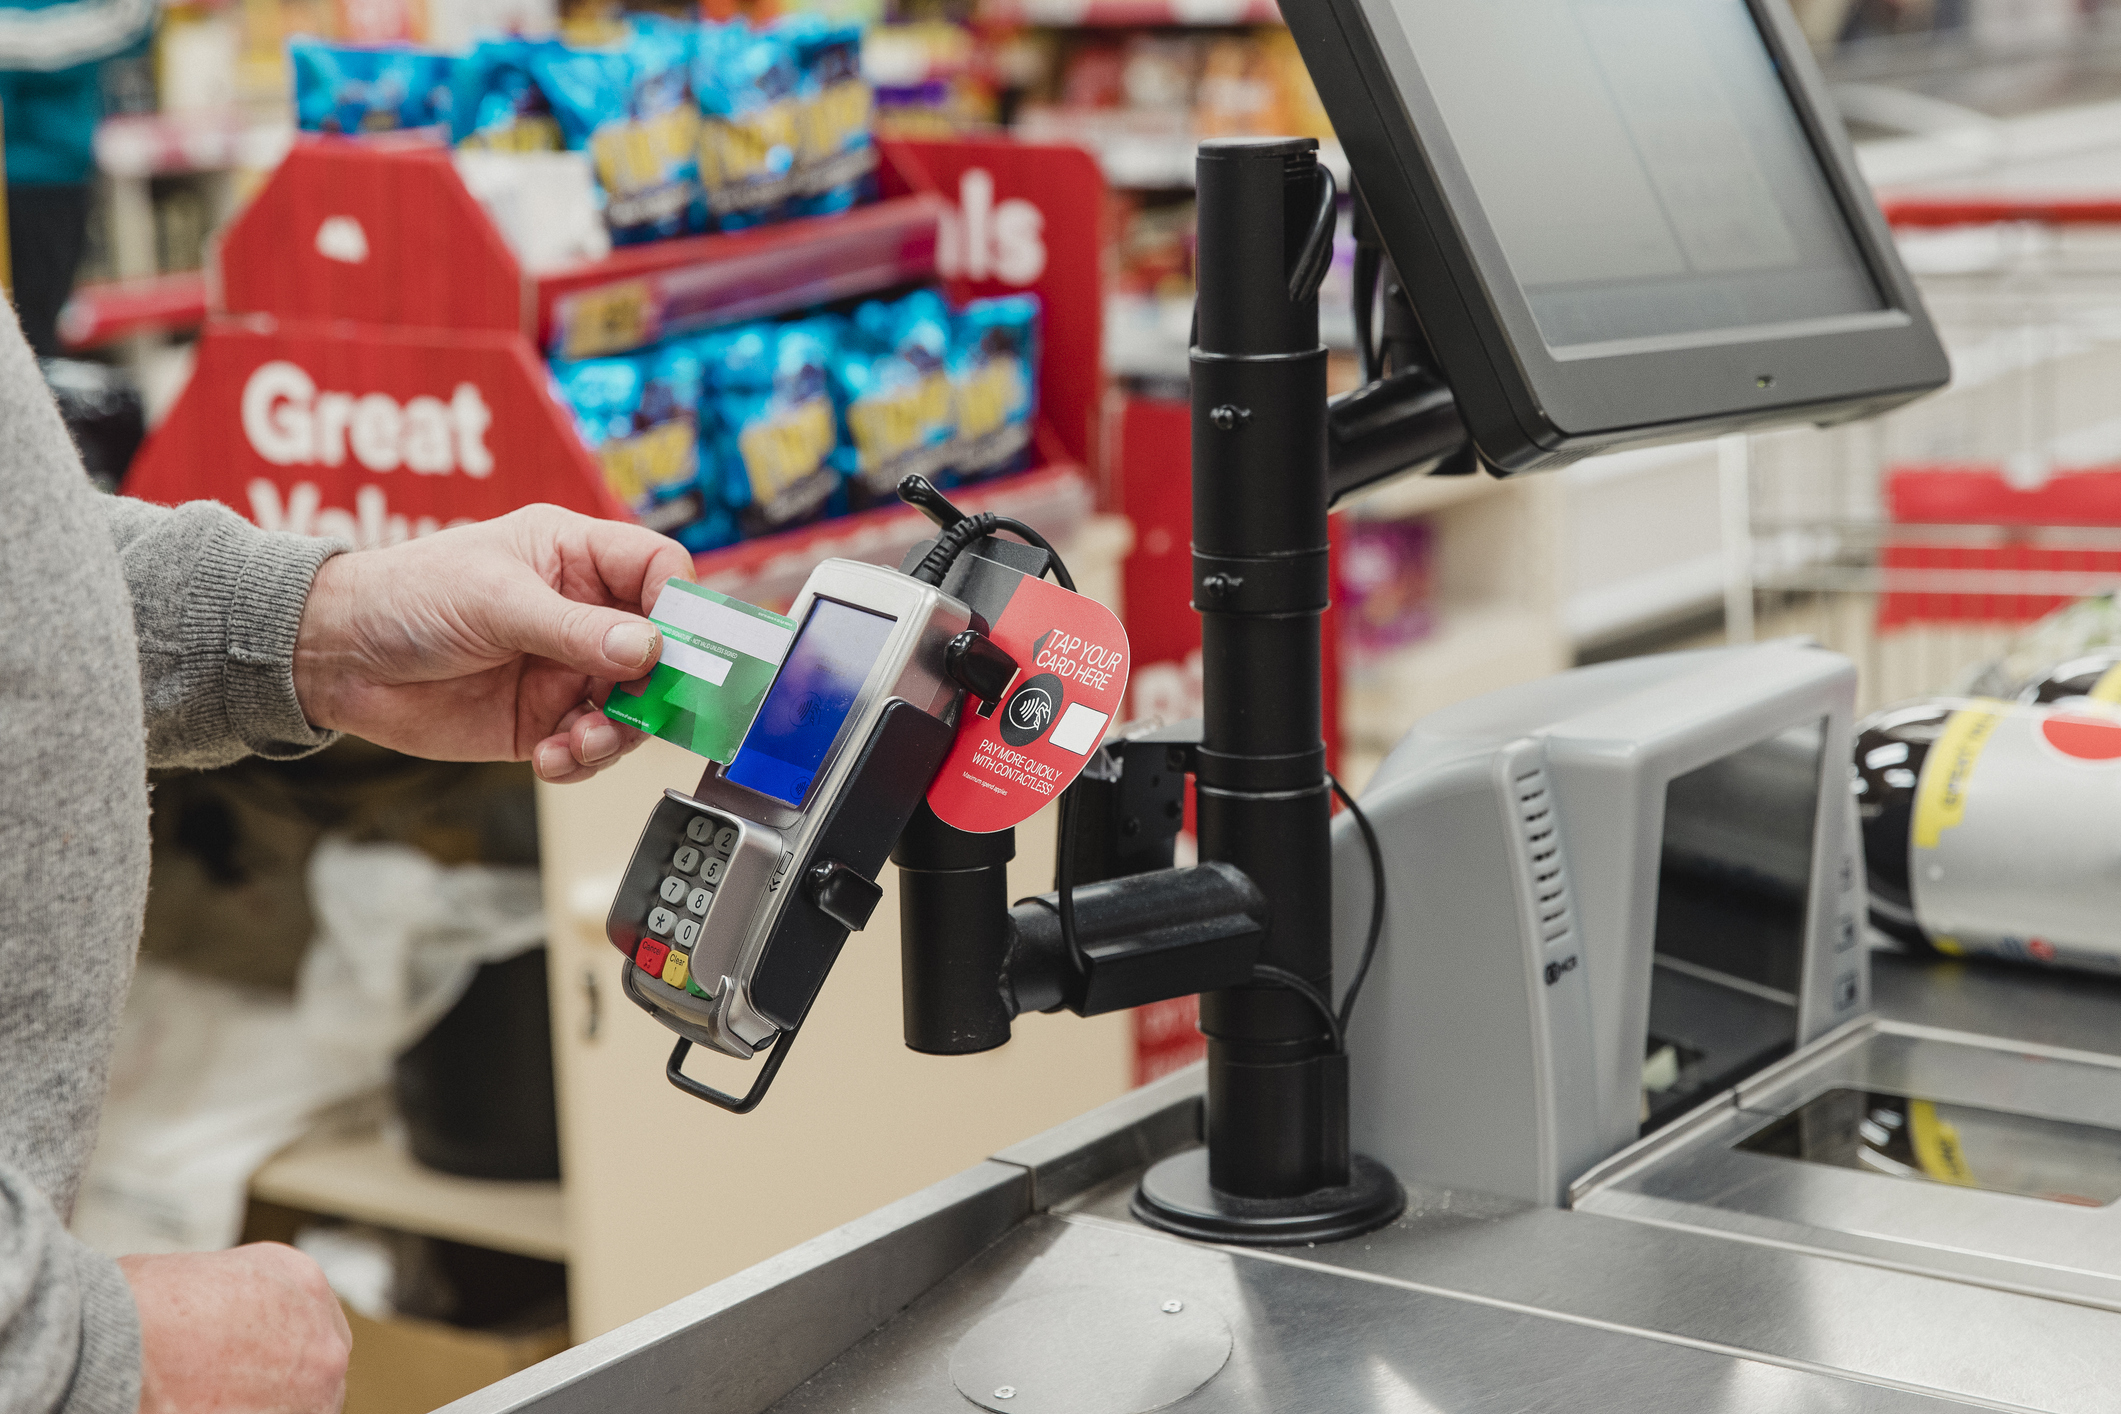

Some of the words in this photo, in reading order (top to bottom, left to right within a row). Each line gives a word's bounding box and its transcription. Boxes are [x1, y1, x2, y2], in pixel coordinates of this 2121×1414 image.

[935, 167, 1047, 286] ls
[241, 361, 494, 478] Great
[1048, 628, 1081, 655] TAP
[1079, 641, 1123, 673] YOUR
[1036, 649, 1076, 677] CARD
[1072, 664, 1112, 691] HERE
[978, 739, 1001, 756] PAY
[997, 747, 1027, 768] MORE
[1024, 759, 1063, 782] QUICKLY
[972, 752, 996, 771] WITH
[994, 762, 1054, 796] CONTACTLESS!
[962, 771, 982, 784] Maximum
[981, 780, 995, 789] spend
[993, 786, 1008, 796] applies
[697, 822, 704, 837] 1
[721, 832, 732, 848] 2
[681, 852, 691, 866] 4
[707, 863, 718, 877] 5
[667, 882, 678, 897] 7
[695, 894, 704, 909] 8
[683, 925, 692, 941] 0
[642, 941, 661, 955] Cancel
[669, 953, 685, 966] Clear
